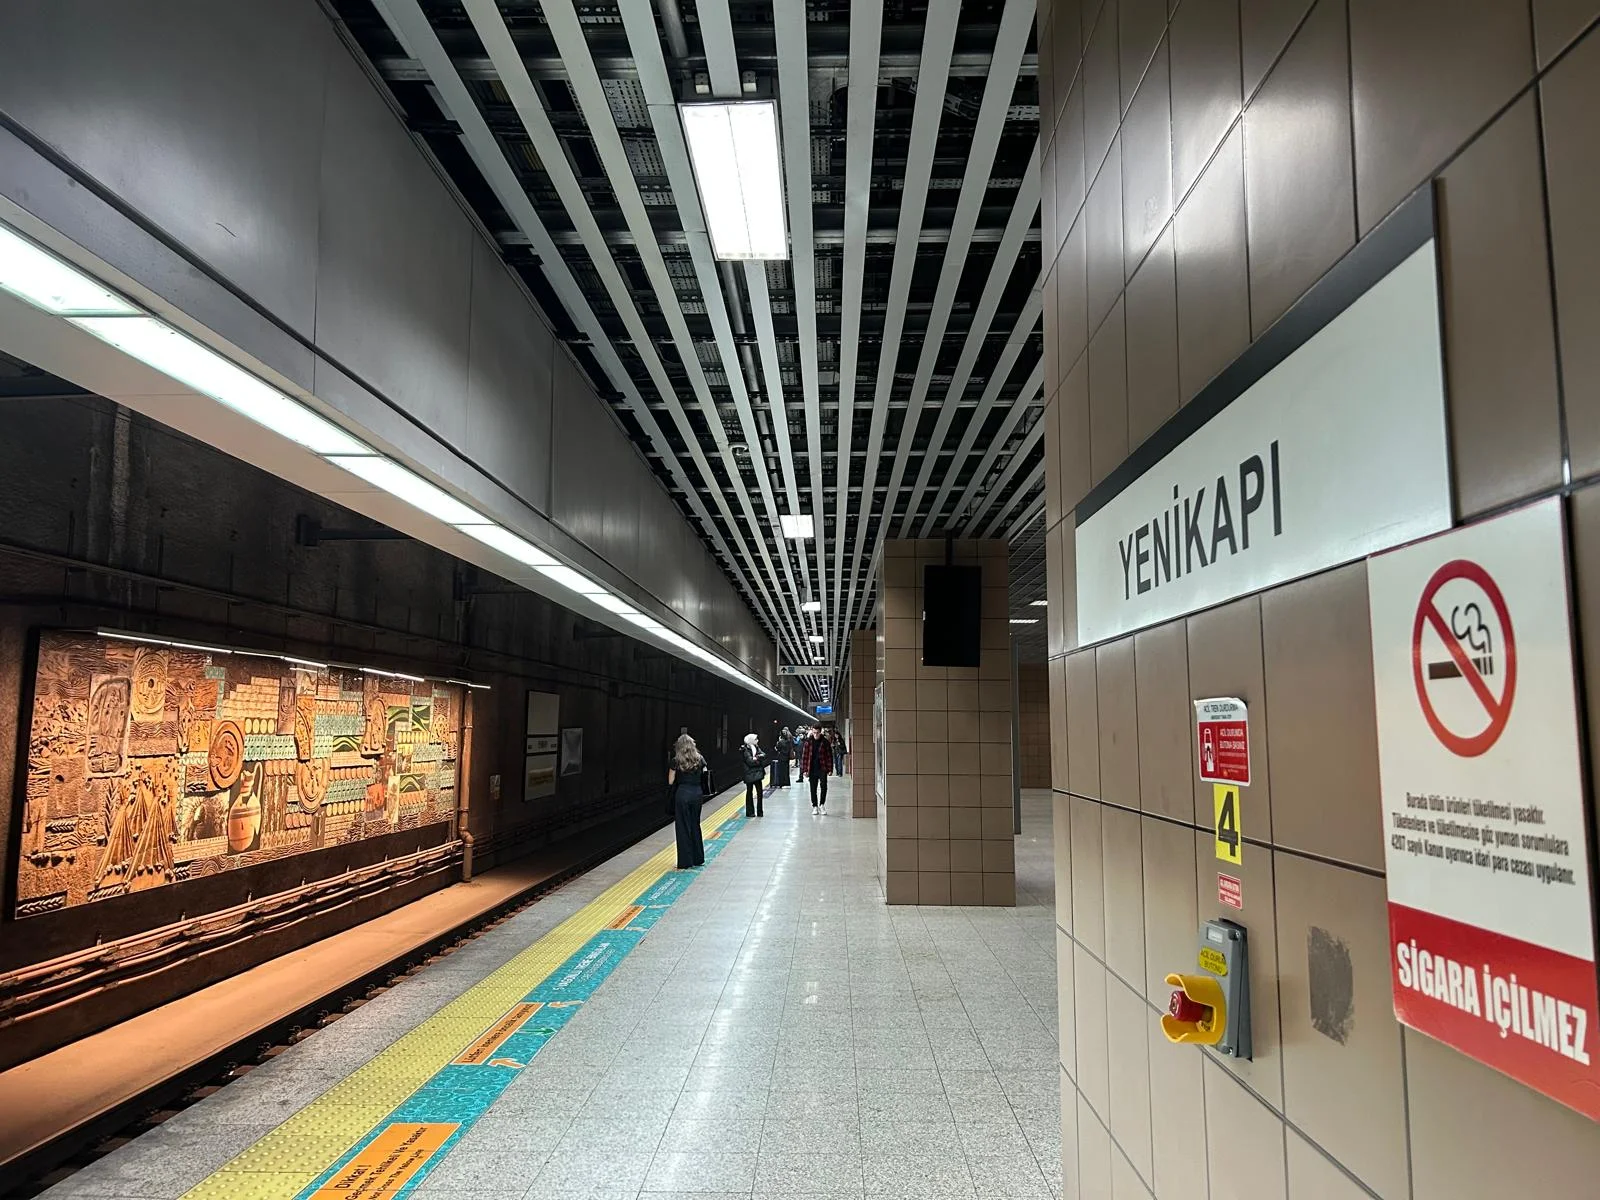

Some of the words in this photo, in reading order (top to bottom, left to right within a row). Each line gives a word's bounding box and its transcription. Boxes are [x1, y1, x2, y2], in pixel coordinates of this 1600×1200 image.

[1119, 440, 1282, 600] YENİKAPI
[1218, 791, 1238, 857] 4
[1406, 792, 1428, 810] Burada
[1428, 794, 1445, 812] tütün
[1446, 796, 1472, 816] ürünleri
[1472, 799, 1512, 820] tüketilmesi
[1513, 804, 1545, 826] yasaktır.
[1428, 821, 1436, 834] ve
[1436, 818, 1480, 842] tüketilmesine
[1481, 825, 1494, 847] göz
[1495, 831, 1520, 849] yuman
[1521, 833, 1570, 857] sorumlulara
[1424, 839, 1444, 859] Kanun
[1445, 846, 1474, 864] uyarınca
[1492, 855, 1509, 874] para
[1510, 858, 1535, 877] cezası
[1536, 862, 1576, 885] uygulanır.
[1397, 938, 1481, 1018] SİGARA
[1483, 964, 1590, 1066] İÇİLMEZ
[334, 1168, 369, 1189] Dikkat
[345, 1176, 377, 1200] Geçmek
[369, 1154, 400, 1176] Tehlikeli
[377, 1179, 395, 1191] Cross
[397, 1158, 415, 1170] Yellow
